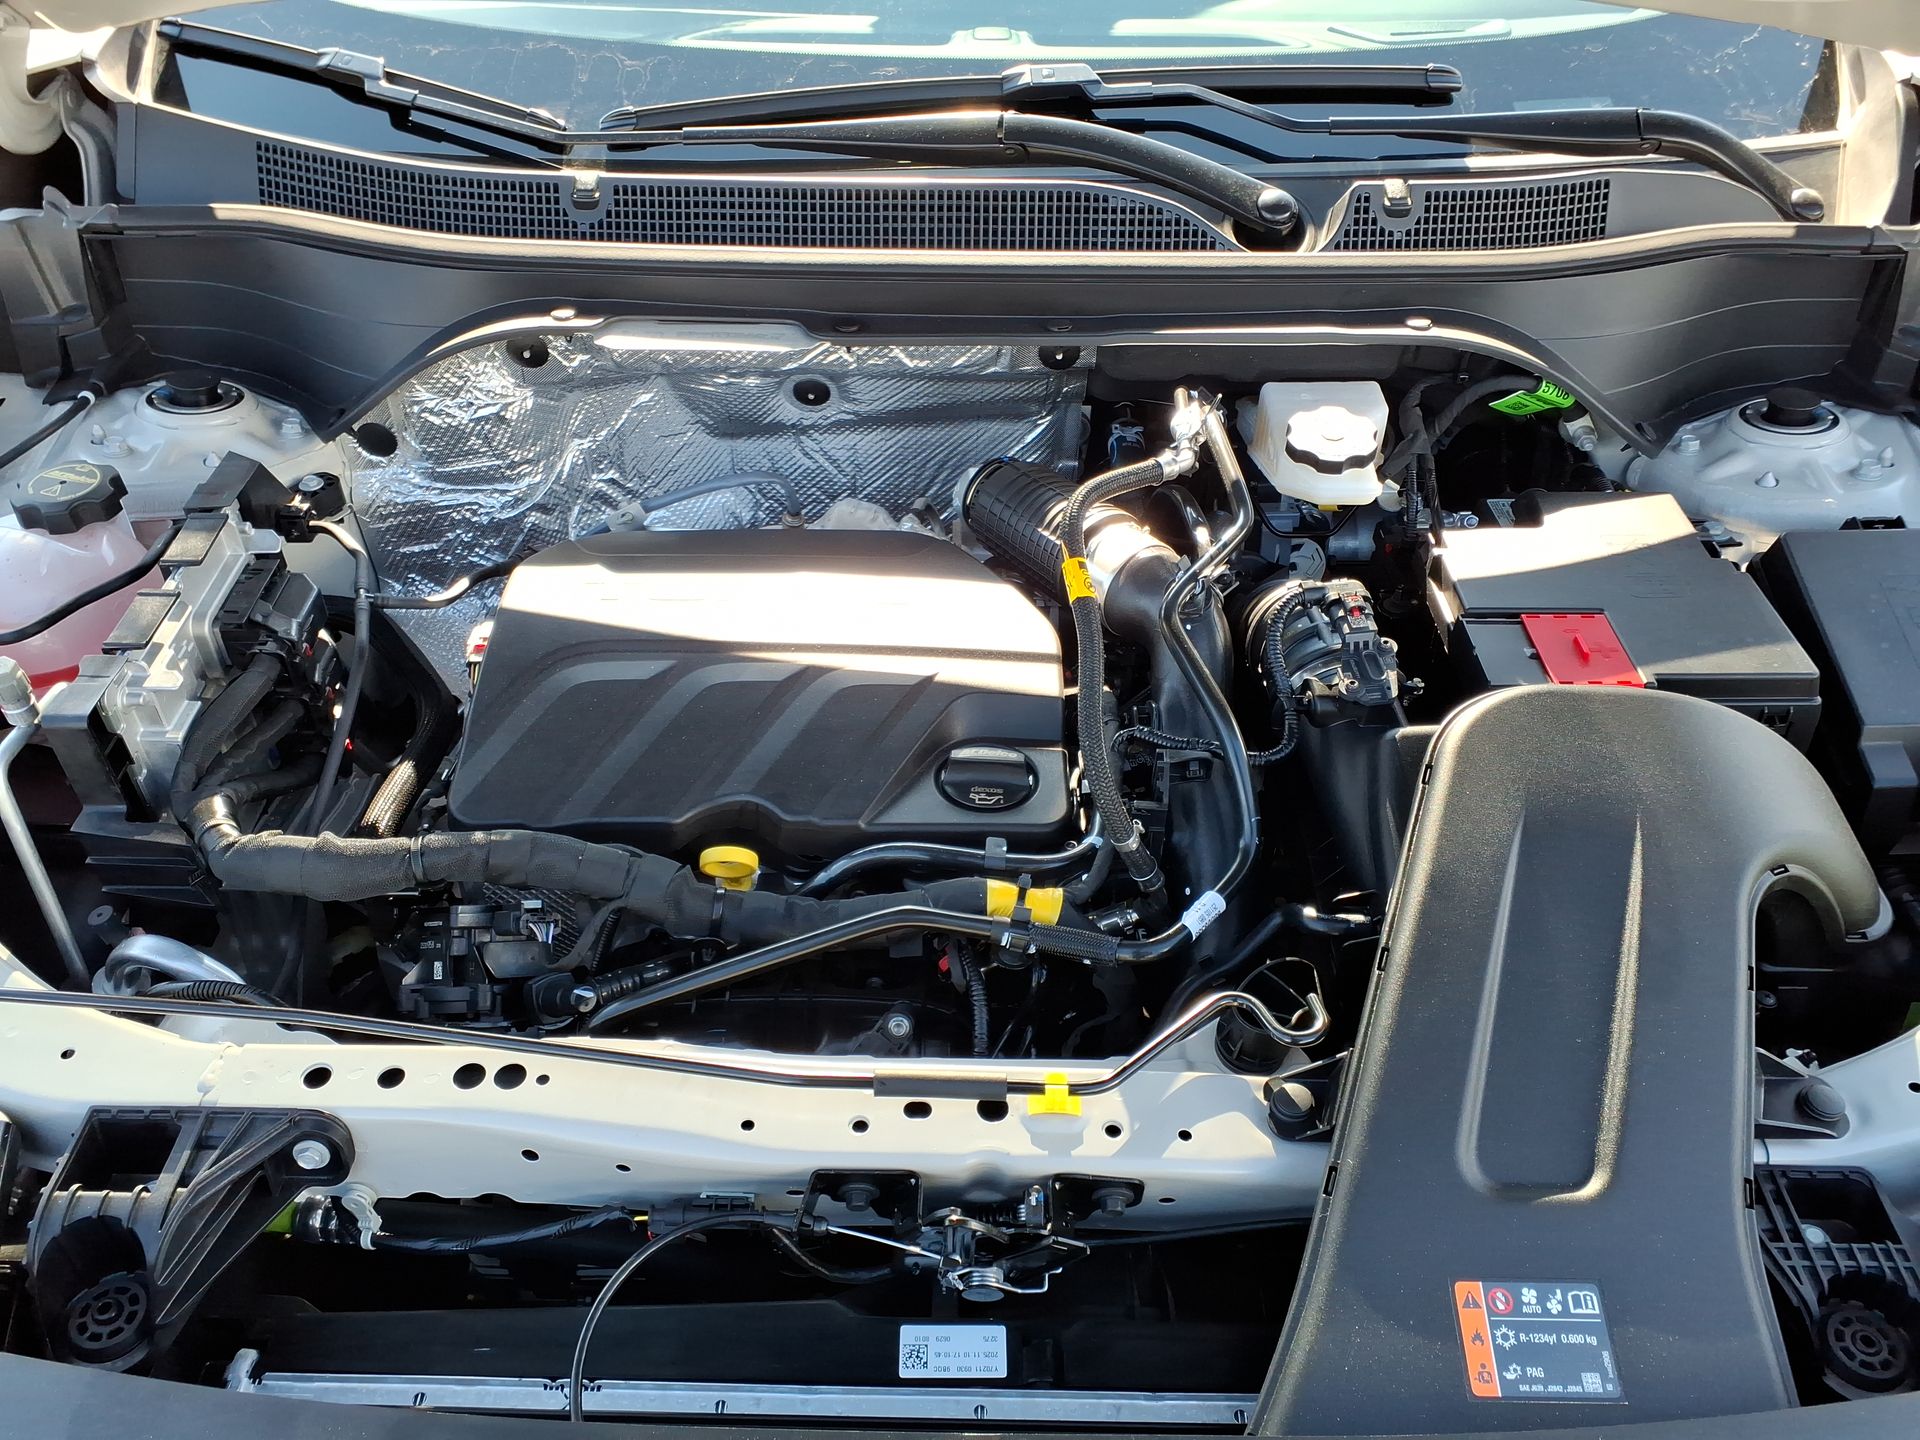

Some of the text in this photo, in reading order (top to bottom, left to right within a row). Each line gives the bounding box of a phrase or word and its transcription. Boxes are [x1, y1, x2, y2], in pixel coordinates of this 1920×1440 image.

[1522, 1304, 1542, 1314] AUTO
[1519, 1333, 1597, 1346] R-1234yf 0.600 kg
[1526, 1367, 1545, 1378] PAG
